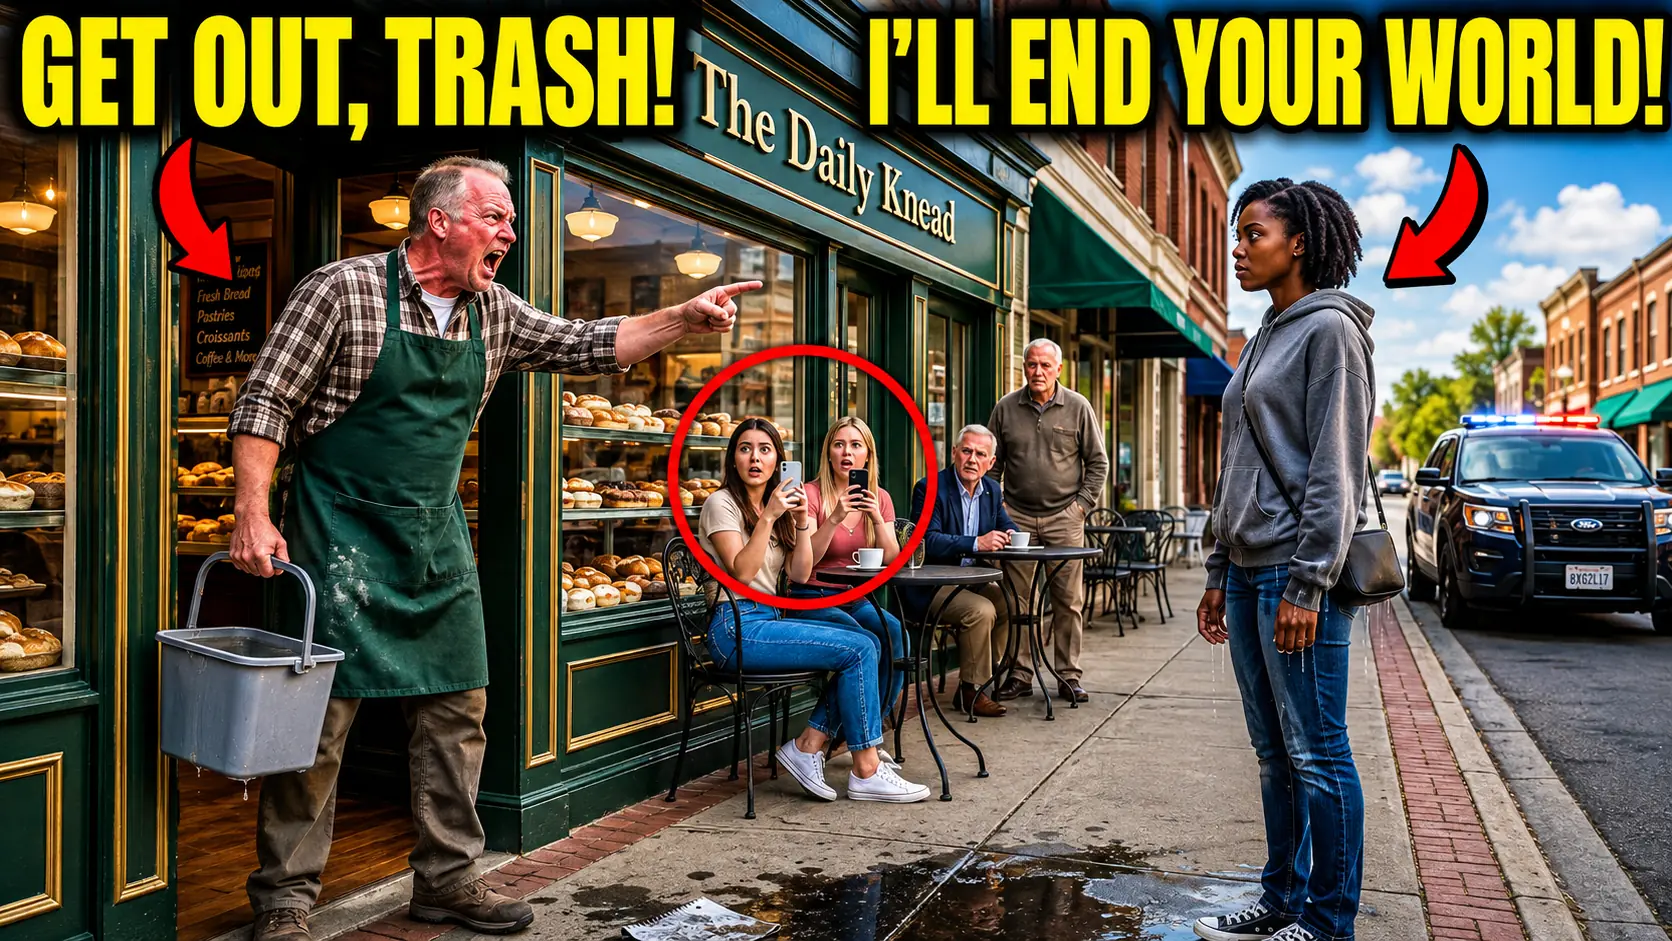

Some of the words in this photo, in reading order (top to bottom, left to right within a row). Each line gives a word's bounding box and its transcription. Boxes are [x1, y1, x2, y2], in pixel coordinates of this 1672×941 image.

[693, 52, 776, 154] The
[786, 107, 875, 216] Daily
[881, 161, 956, 245] Knead
[197, 288, 221, 302] Fresh
[223, 286, 252, 301] Bread
[197, 308, 235, 323] Pastries
[196, 329, 250, 344] Croissants
[195, 351, 224, 367] Coffee
[226, 351, 232, 364] &
